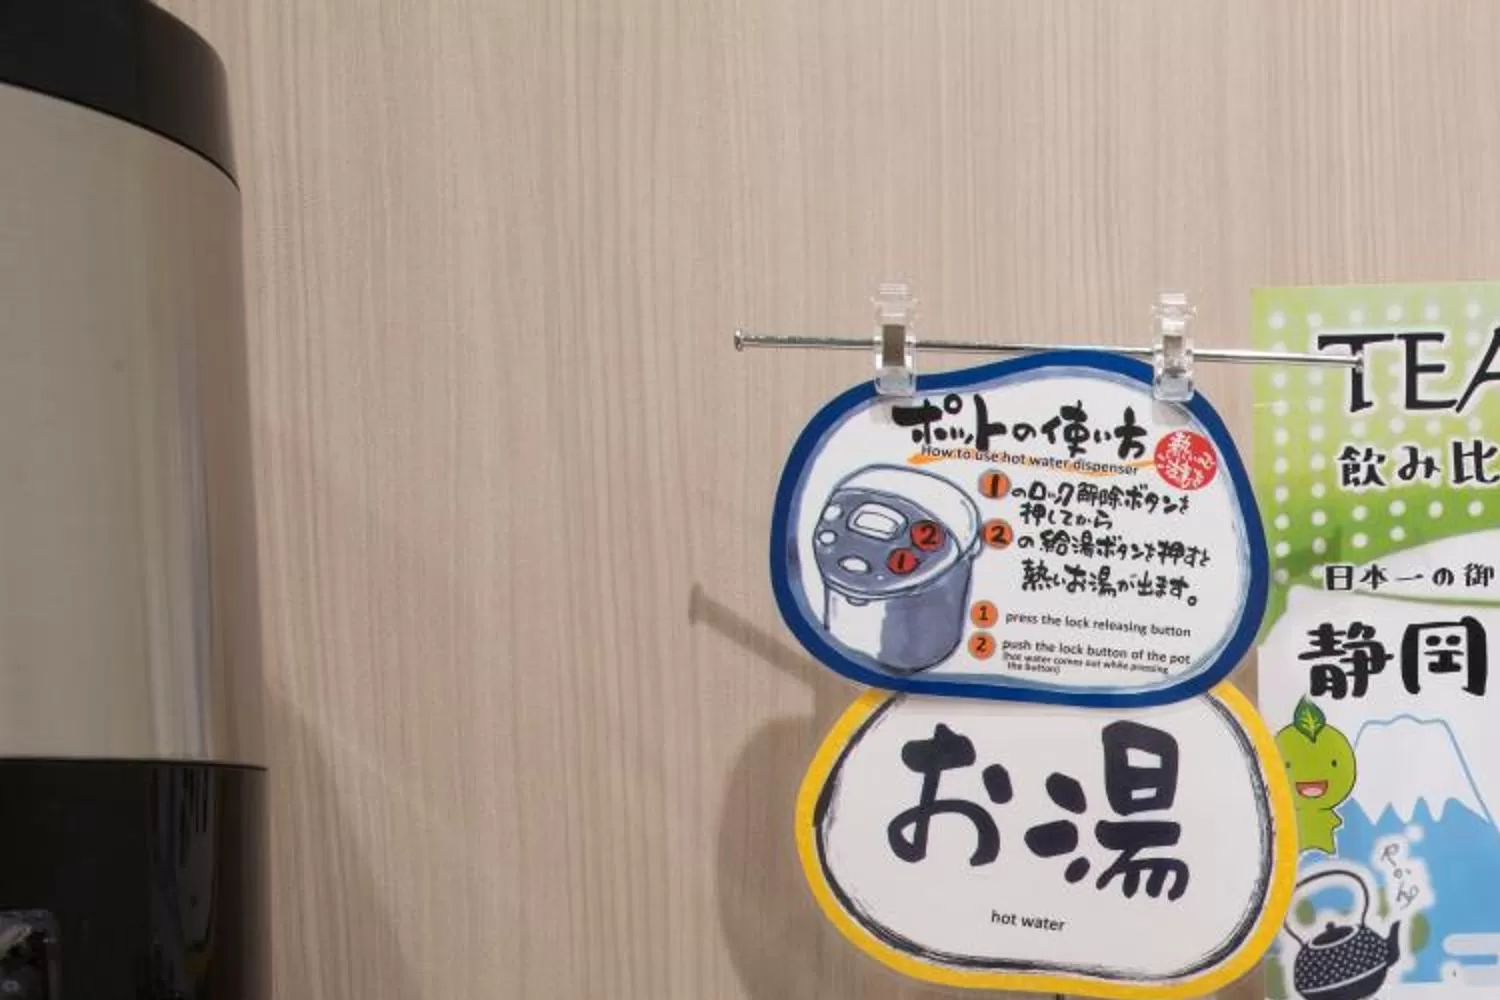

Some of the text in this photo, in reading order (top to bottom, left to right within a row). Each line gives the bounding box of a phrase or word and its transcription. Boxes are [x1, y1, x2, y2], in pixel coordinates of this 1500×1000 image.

[892, 394, 1148, 462] ポットの使い方
[921, 445, 1138, 475] How to use hot water dispenser
[1011, 481, 1190, 515] のロック解除ボタンを
[1019, 501, 1113, 530] 押してから
[1018, 529, 1211, 568] の給湯ボタンを押すと
[1021, 558, 1198, 606] 熱いお湯が出ます。
[1005, 613, 1039, 625] press
[1041, 614, 1062, 627] the
[1065, 615, 1089, 629] lock
[1093, 618, 1147, 636] releasing
[1150, 623, 1191, 638] button
[1002, 640, 1031, 651] push
[1035, 641, 1056, 653] the
[1059, 642, 1084, 656] lock
[1087, 644, 1127, 660] button
[1131, 648, 1145, 660] of
[1147, 649, 1167, 663] the
[1169, 654, 1191, 665] pot
[887, 720, 1190, 901] お湯
[991, 909, 1067, 932] hot water
